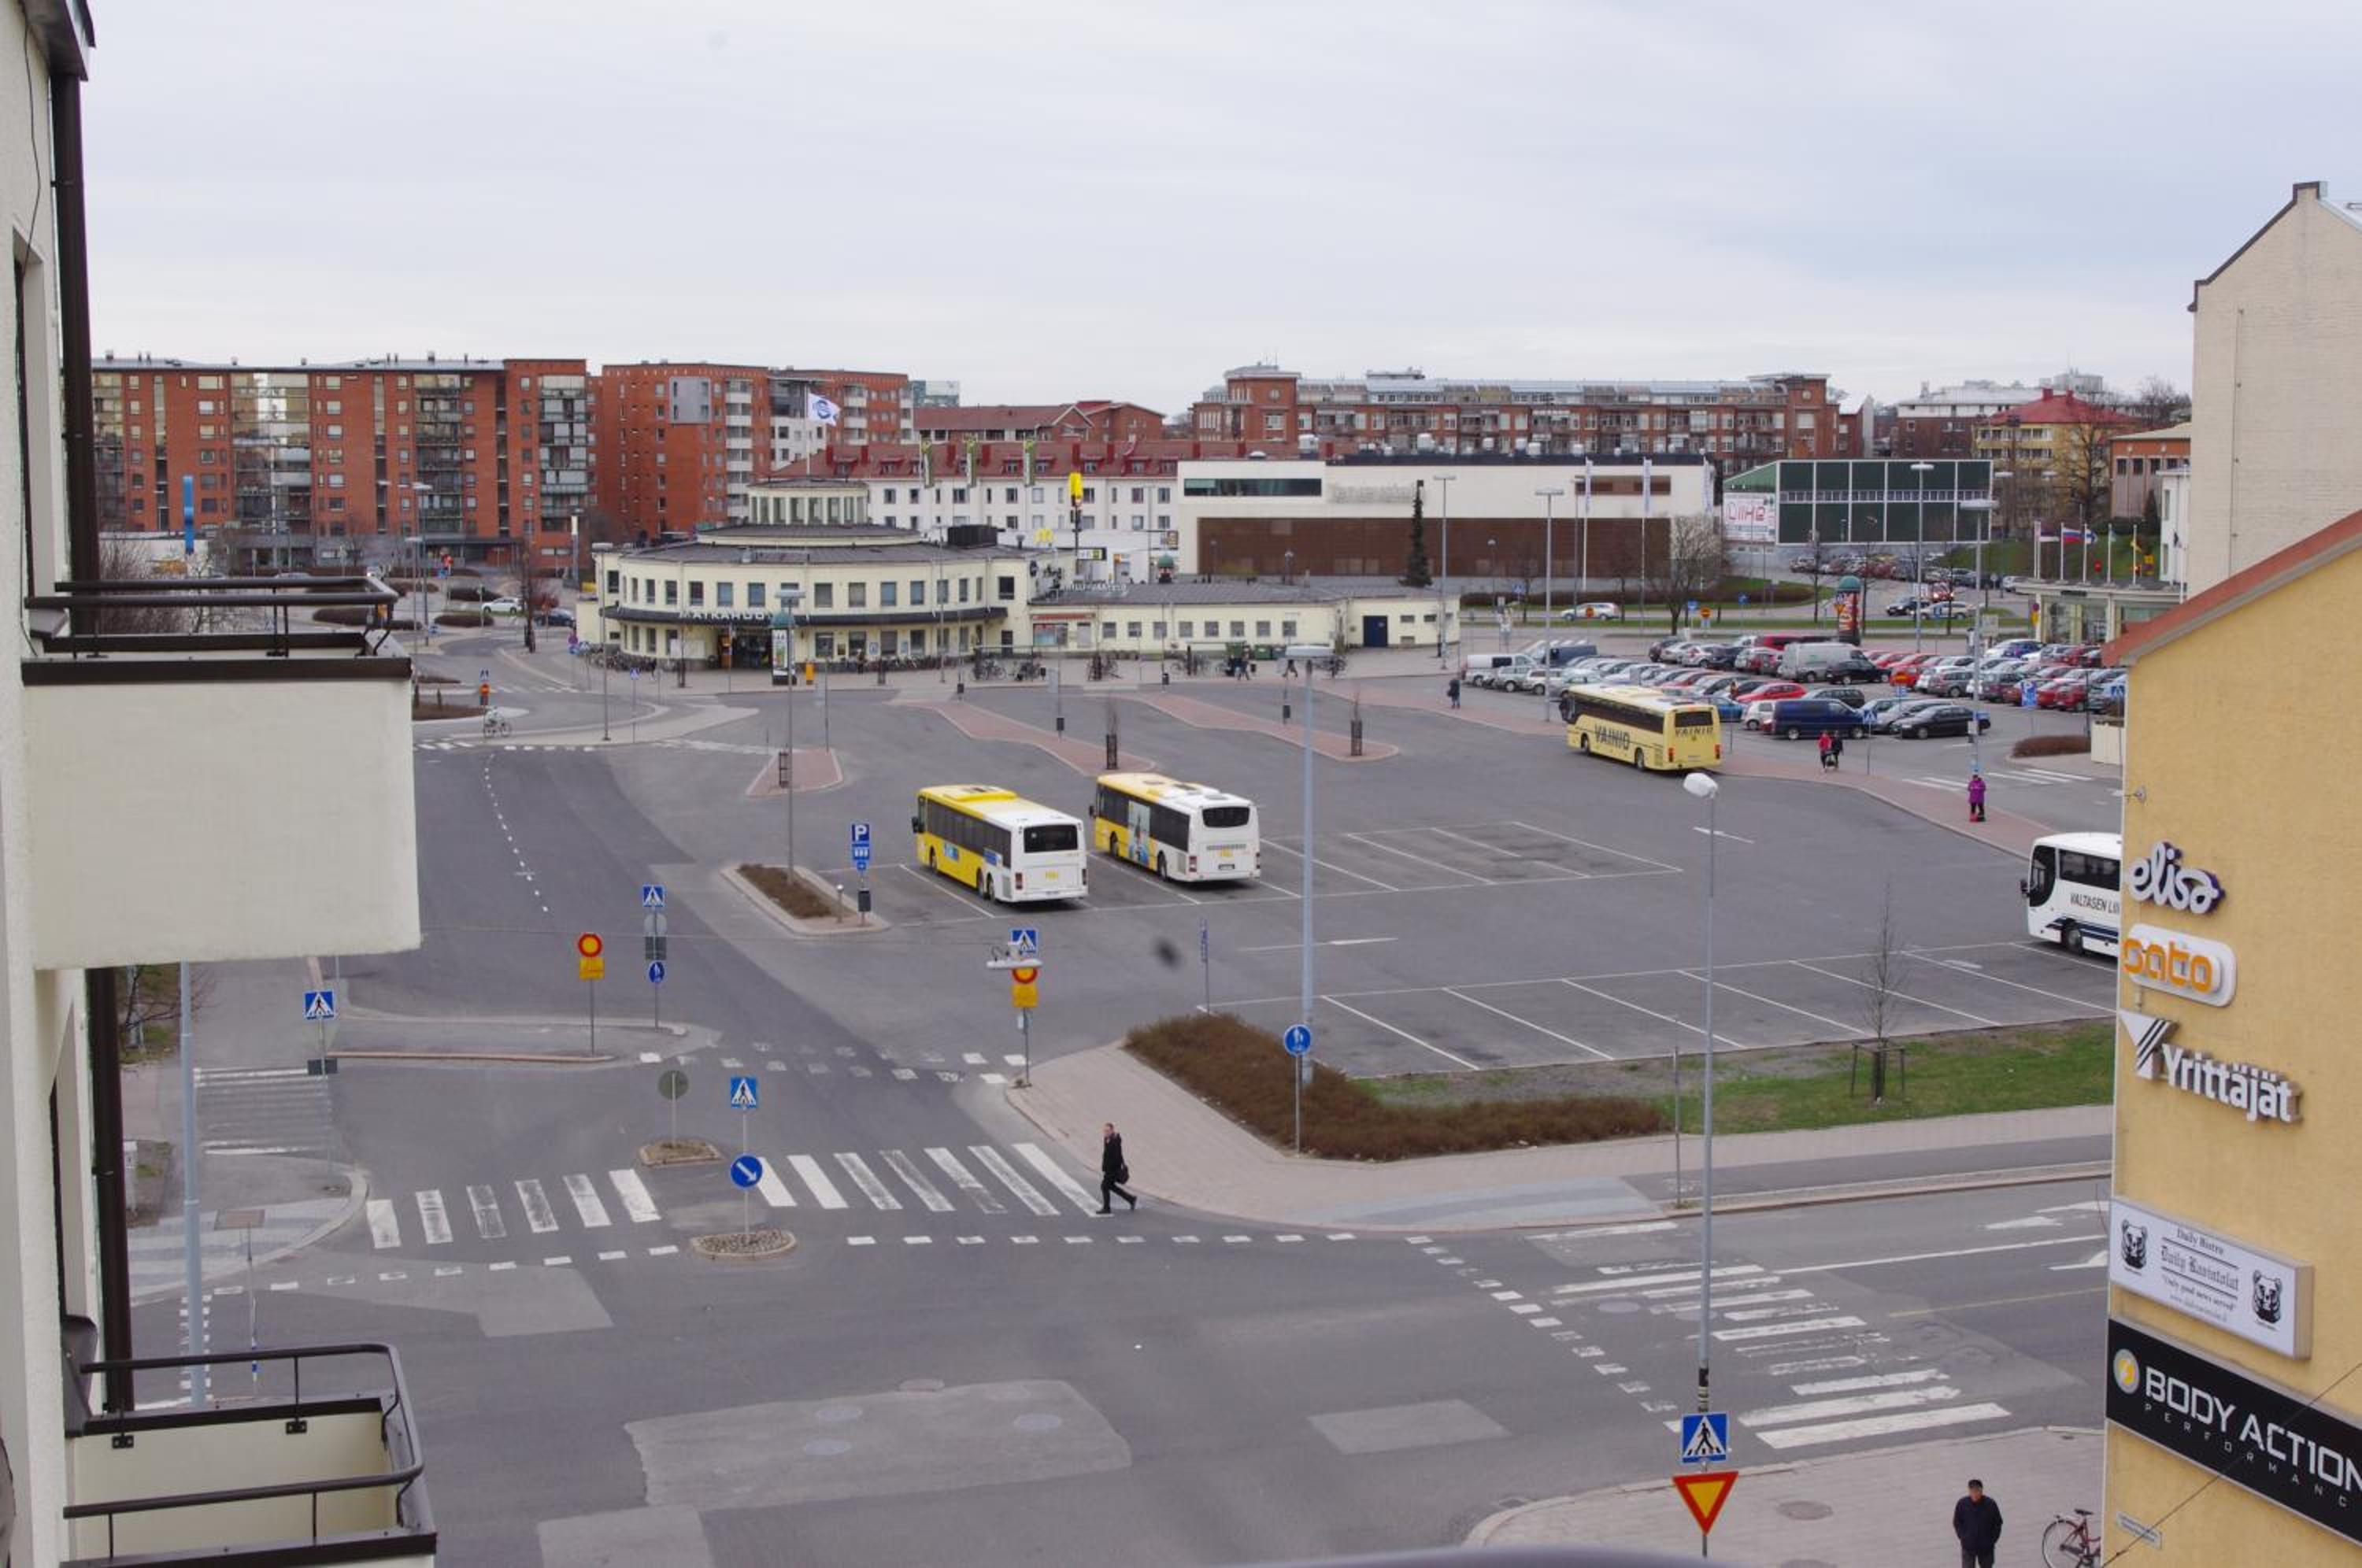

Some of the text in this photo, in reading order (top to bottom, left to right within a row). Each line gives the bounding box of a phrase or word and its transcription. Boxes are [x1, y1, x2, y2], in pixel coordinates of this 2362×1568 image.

[1594, 724, 1630, 749] VAINIO
[1675, 727, 1713, 737] VAINIO
[2128, 841, 2220, 914] elisa
[2123, 937, 2213, 993] sato
[2162, 1043, 2293, 1122] Yrittäjät
[2145, 1366, 2236, 1433] BODY
